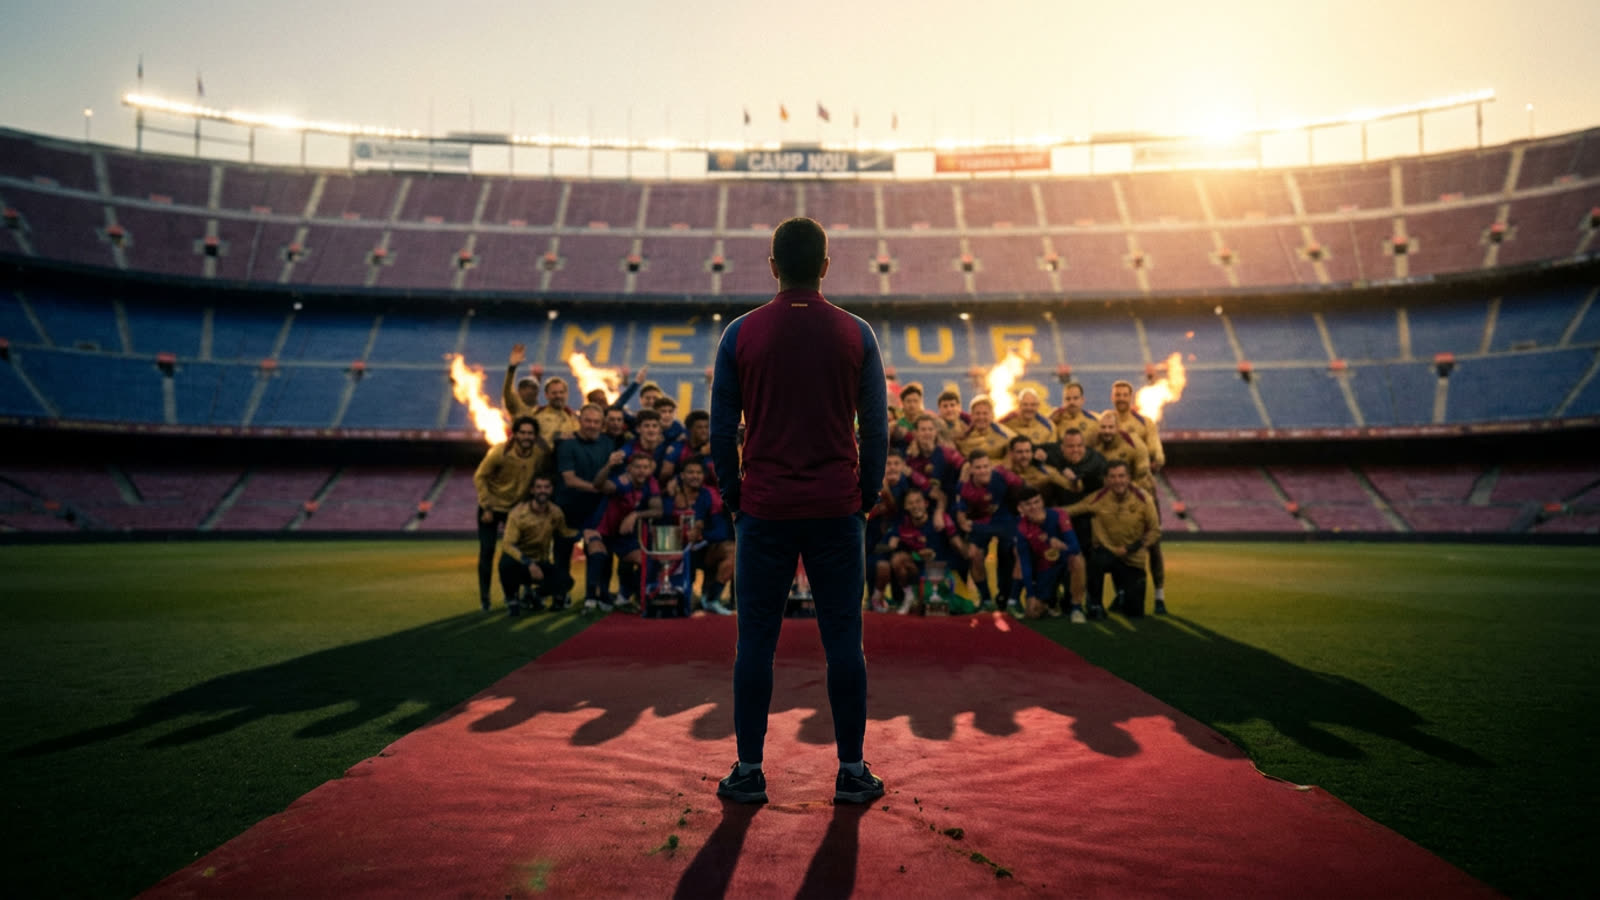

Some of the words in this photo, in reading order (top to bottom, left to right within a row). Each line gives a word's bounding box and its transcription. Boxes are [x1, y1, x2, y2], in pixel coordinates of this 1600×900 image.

[748, 152, 804, 171] CAMP
[808, 152, 849, 171] NOU
[560, 317, 700, 365] MÉ
[906, 325, 1041, 365] UE
